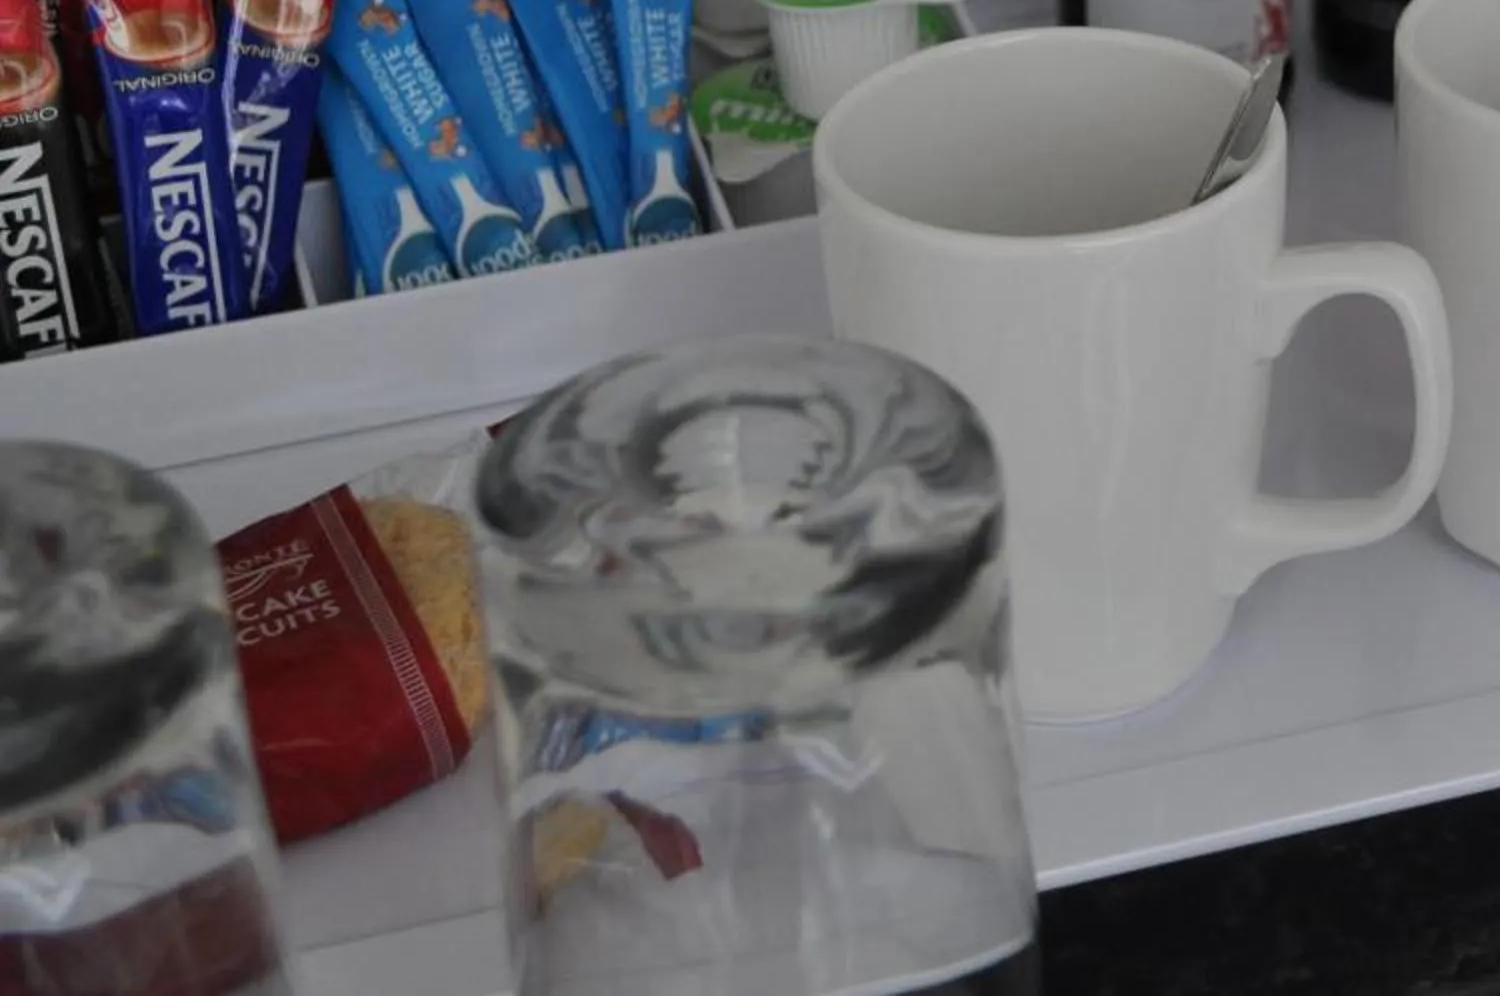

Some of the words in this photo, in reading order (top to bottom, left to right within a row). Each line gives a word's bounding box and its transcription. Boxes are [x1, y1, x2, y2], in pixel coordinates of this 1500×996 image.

[112, 67, 216, 93] ORIGINAL
[381, 45, 434, 125] WHITE
[404, 40, 451, 110] SUGAR
[489, 31, 532, 117] WHITE
[644, 6, 671, 90] WHITE
[0, 106, 58, 130] ORIG
[0, 140, 80, 359] NESCAF
[235, 578, 332, 622] CAKE
